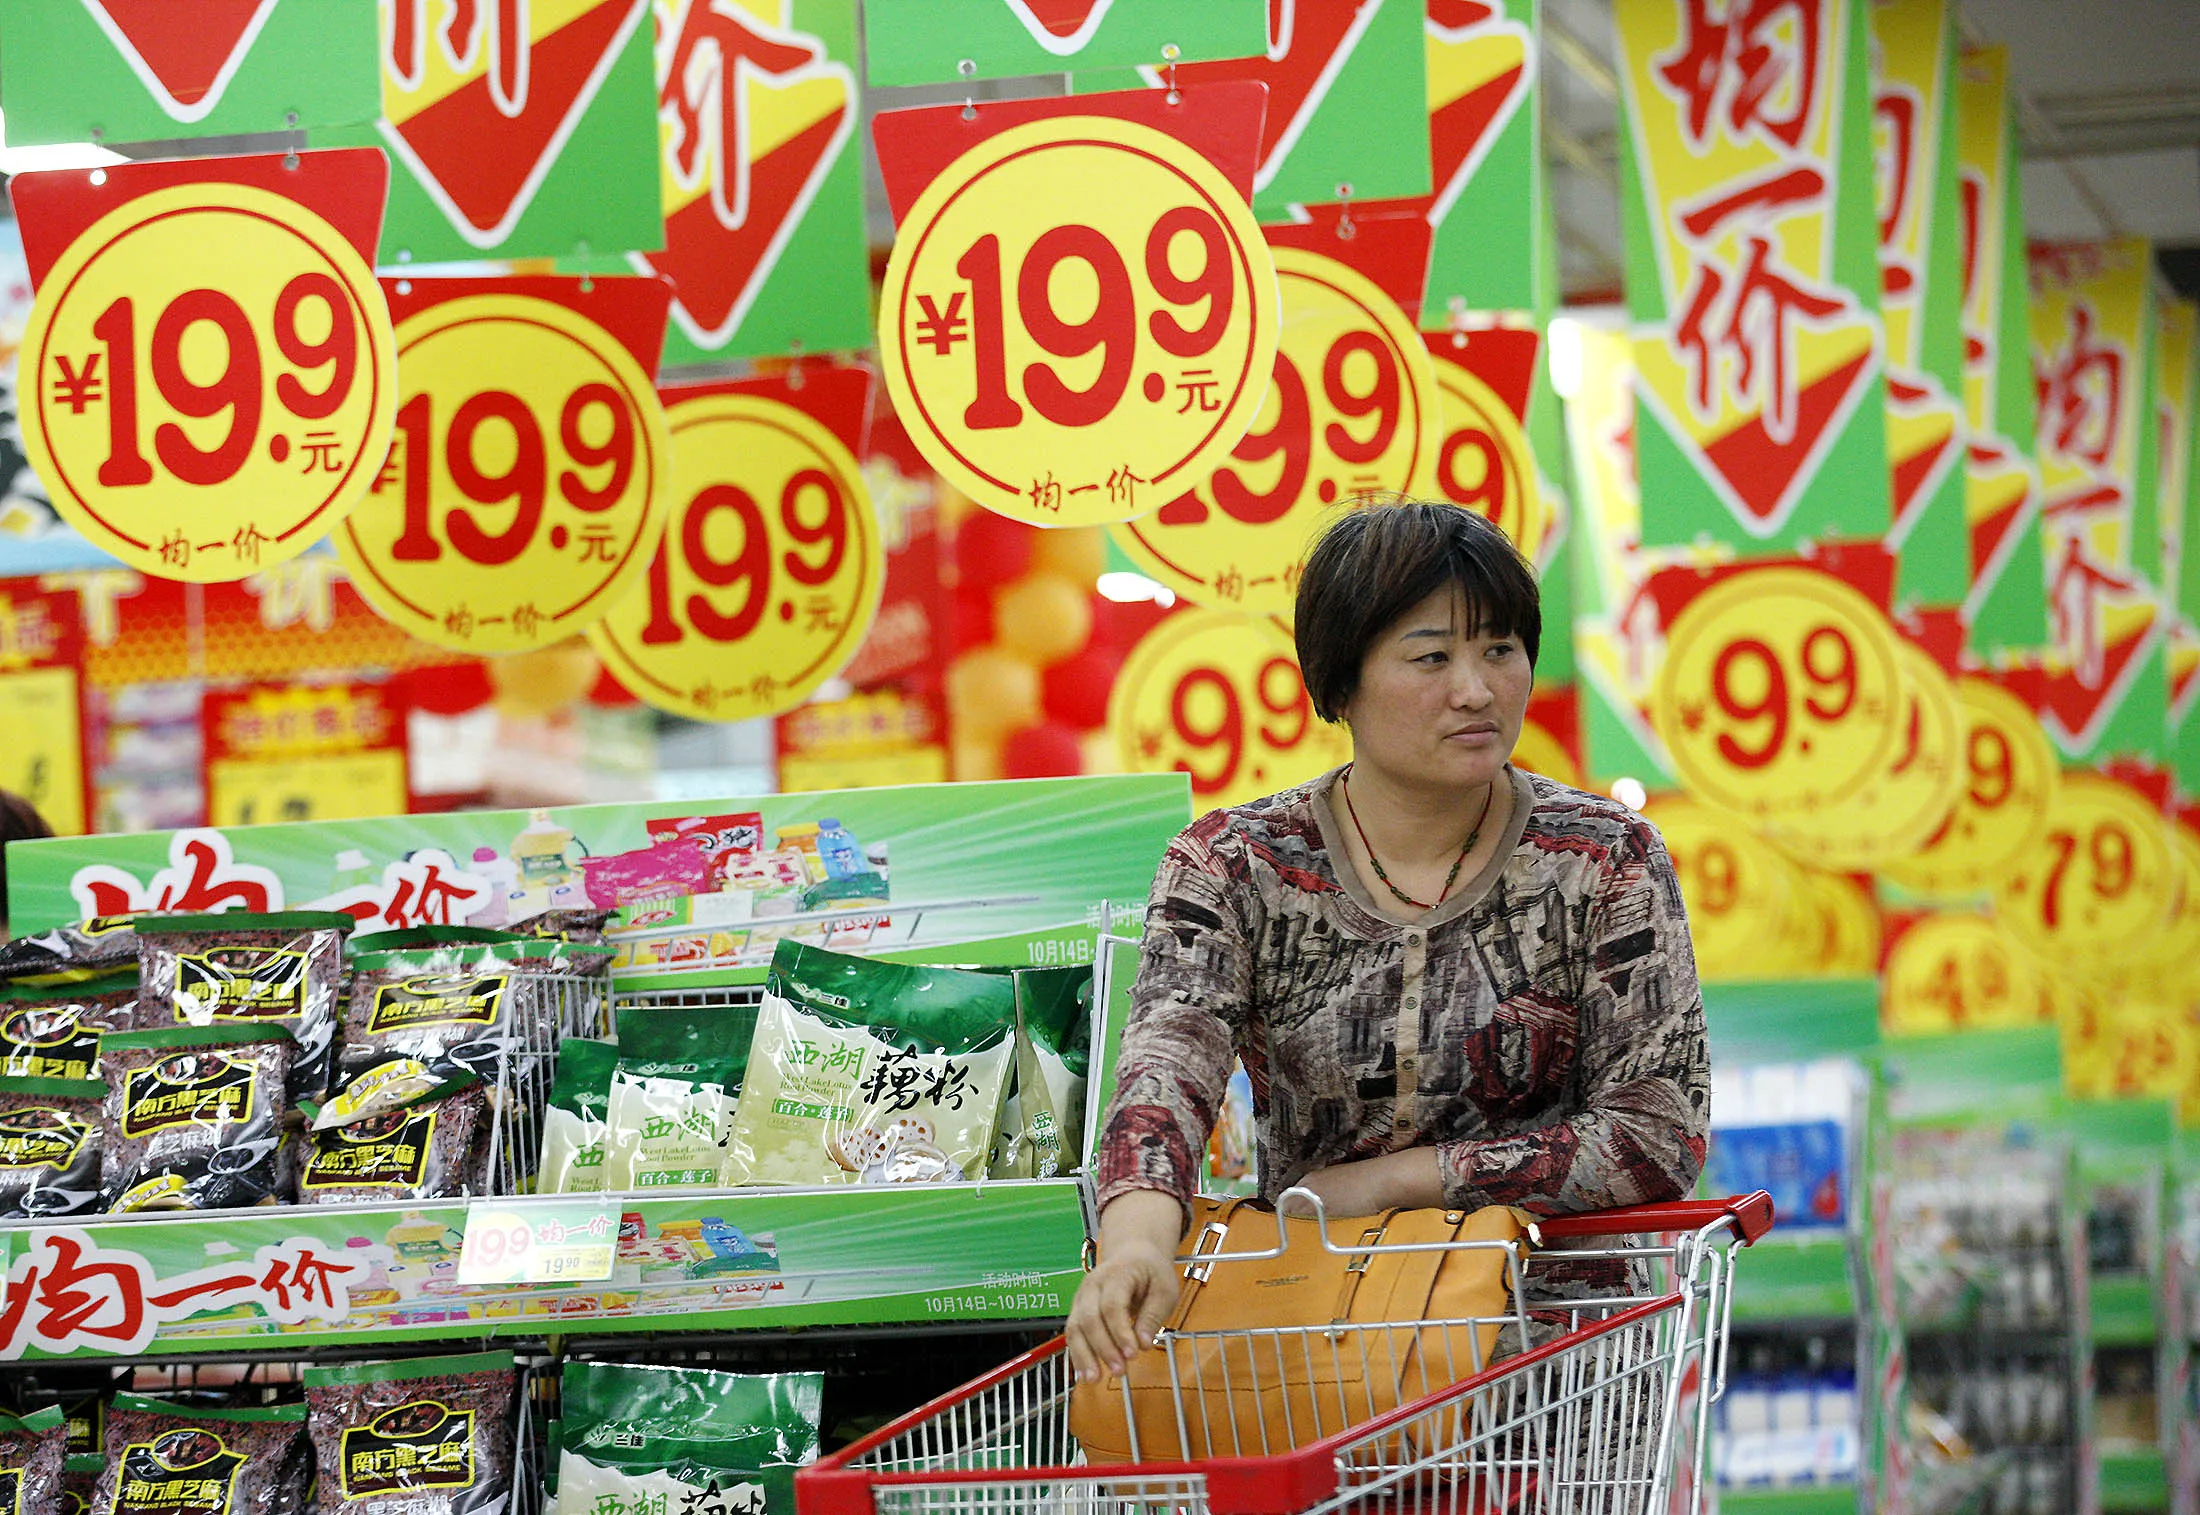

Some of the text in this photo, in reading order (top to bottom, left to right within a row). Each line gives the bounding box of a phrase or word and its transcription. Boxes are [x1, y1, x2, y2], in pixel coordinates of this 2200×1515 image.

[1175, 369, 1221, 415] 元
[300, 432, 343, 473] 元
[1028, 465, 1146, 513] 均一价
[158, 522, 269, 568] 均一价
[578, 523, 617, 564] 元
[444, 602, 552, 641] 均一价
[539, 1217, 614, 1242] 均一价
[126, 1478, 222, 1501] 南方黑芝麻
